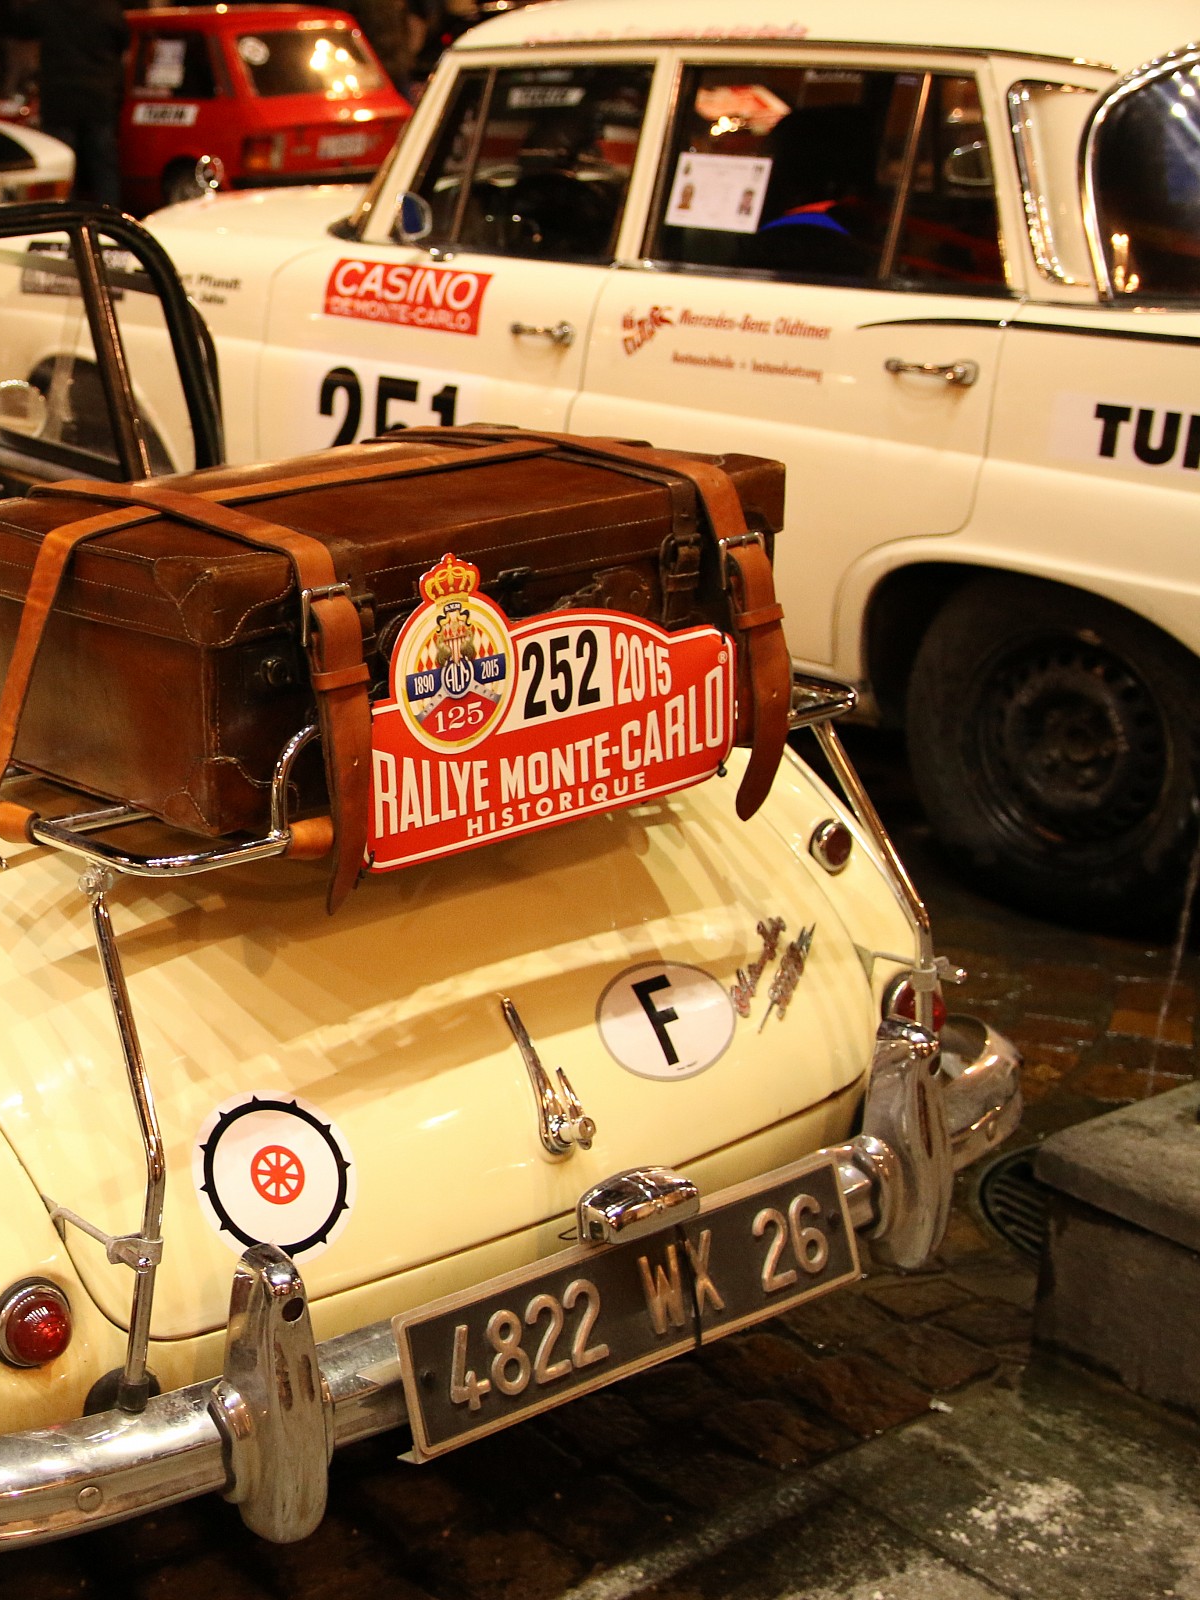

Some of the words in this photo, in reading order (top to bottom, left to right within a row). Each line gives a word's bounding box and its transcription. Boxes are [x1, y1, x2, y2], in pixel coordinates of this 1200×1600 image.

[334, 261, 479, 311] CASINO
[413, 674, 435, 696] 1890
[480, 658, 499, 680] 2015
[522, 629, 601, 720] 252
[615, 632, 672, 706] 2015
[372, 749, 489, 839] RALLYE
[500, 665, 724, 800] MONTE-CARLO
[435, 701, 484, 734] 125
[467, 771, 647, 838] HISTORIQUE
[631, 974, 680, 1066] F
[449, 1278, 610, 1412] 4822
[638, 1229, 725, 1335] WX
[751, 1194, 830, 1294] 26
